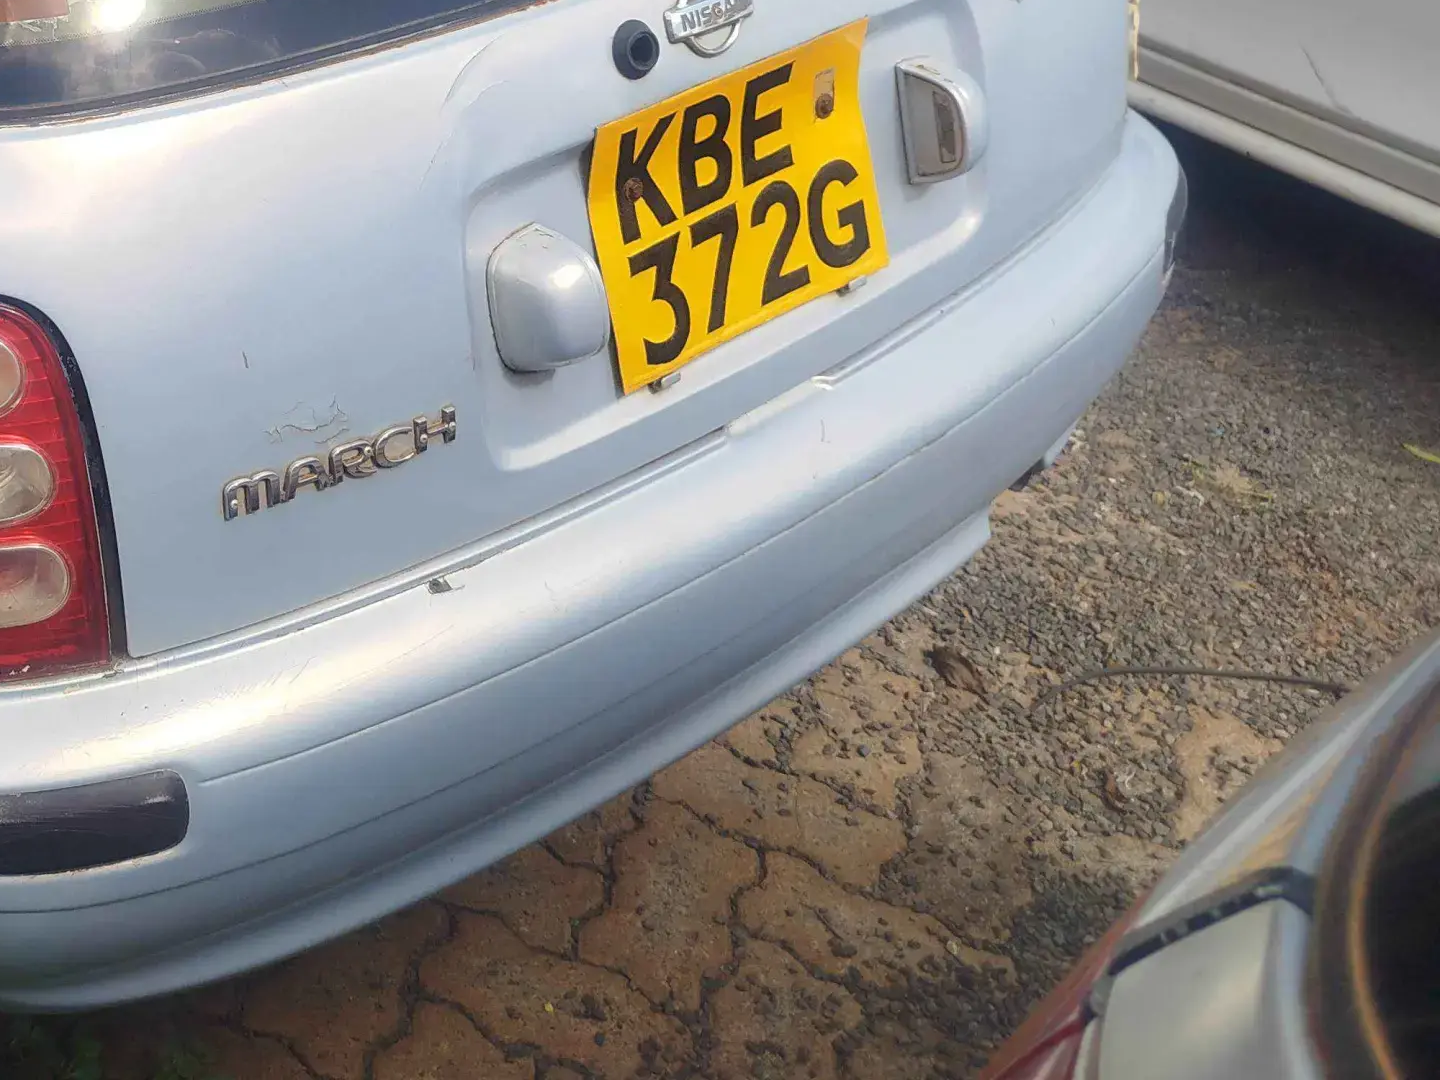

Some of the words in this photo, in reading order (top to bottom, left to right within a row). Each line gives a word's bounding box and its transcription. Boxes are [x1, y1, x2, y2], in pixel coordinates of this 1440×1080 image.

[615, 60, 796, 246] KBE
[627, 159, 872, 366] 372G
[222, 404, 456, 521] MARCH
